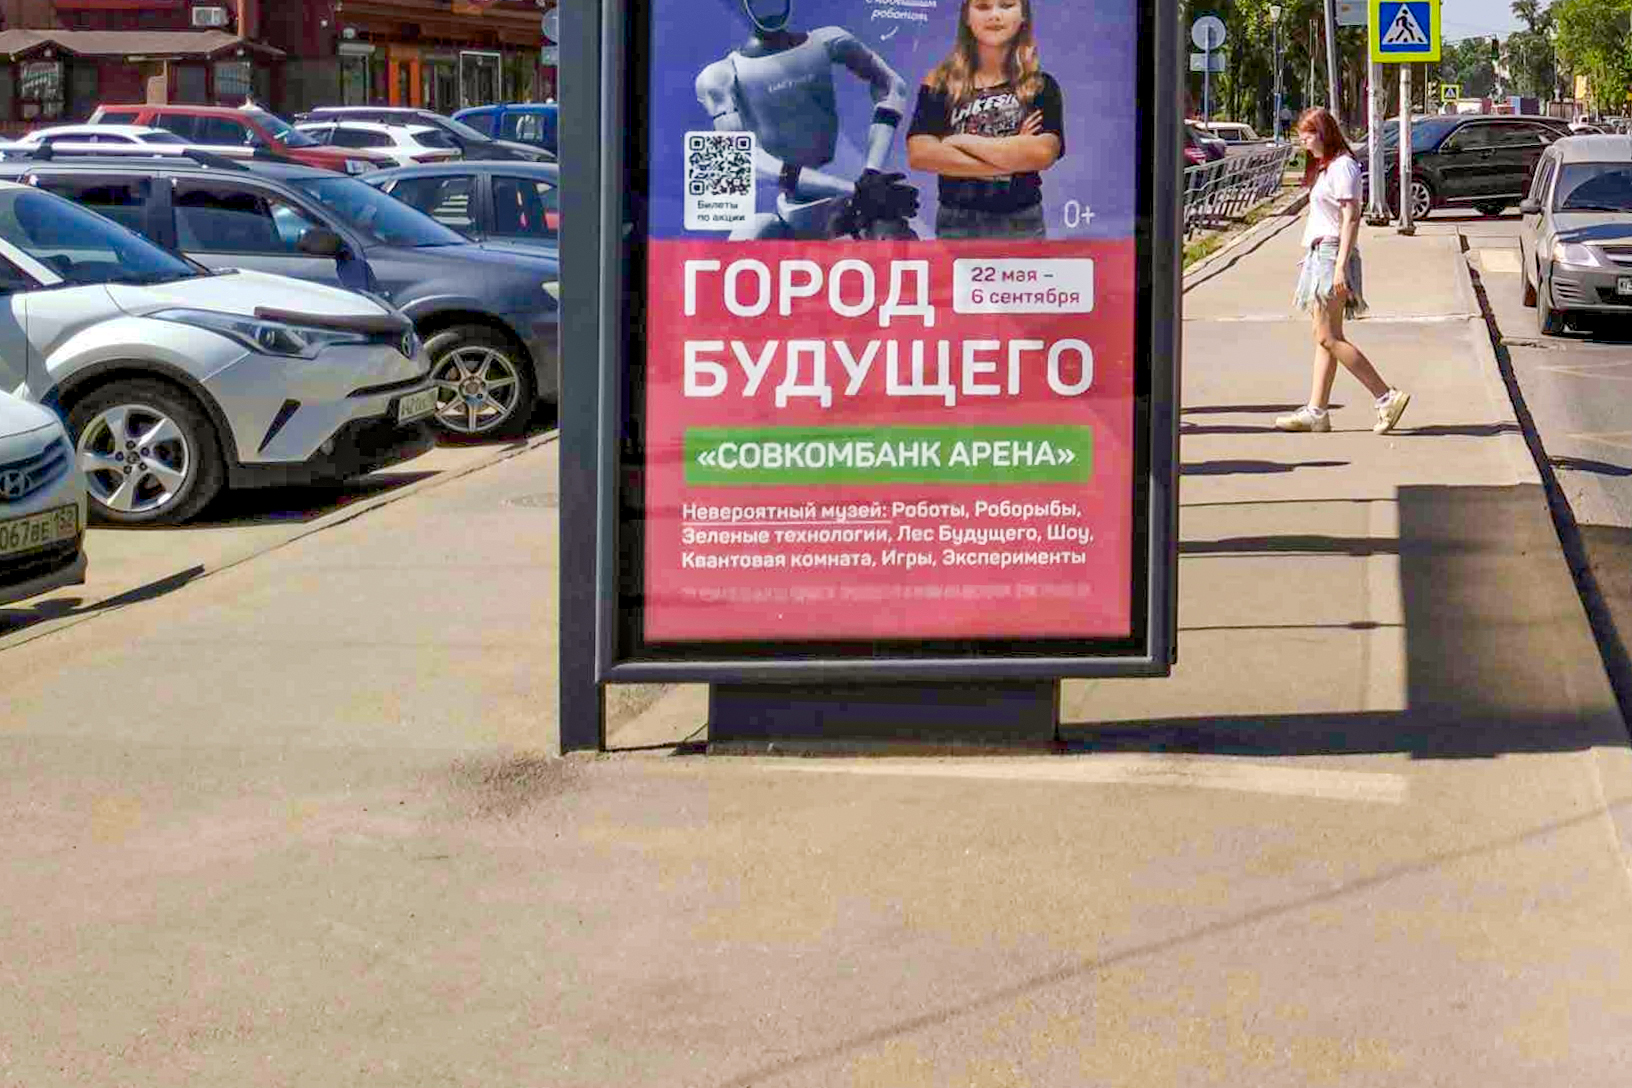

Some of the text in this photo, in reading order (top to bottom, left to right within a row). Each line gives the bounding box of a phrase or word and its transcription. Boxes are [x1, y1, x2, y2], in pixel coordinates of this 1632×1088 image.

[697, 200, 739, 210] Билеты
[1063, 200, 1096, 228] 0+
[712, 214, 746, 223] акции
[971, 266, 996, 283] 22
[1001, 270, 1038, 283] мая
[684, 258, 935, 328] ГОРОД
[971, 287, 1080, 307] 6 сентября
[684, 338, 1094, 408] БУДУЩЕГО
[697, 439, 1077, 471] «СОВКОМБАНК АРЕНА»
[682, 500, 1083, 523] Невероятный музей: Роботы, Роборыбы,
[681, 524, 1095, 546] Зеленые технологии, Лес Будущего, Шоу,
[681, 548, 1086, 571] Квантовая комната, Игры, Эксперименты
